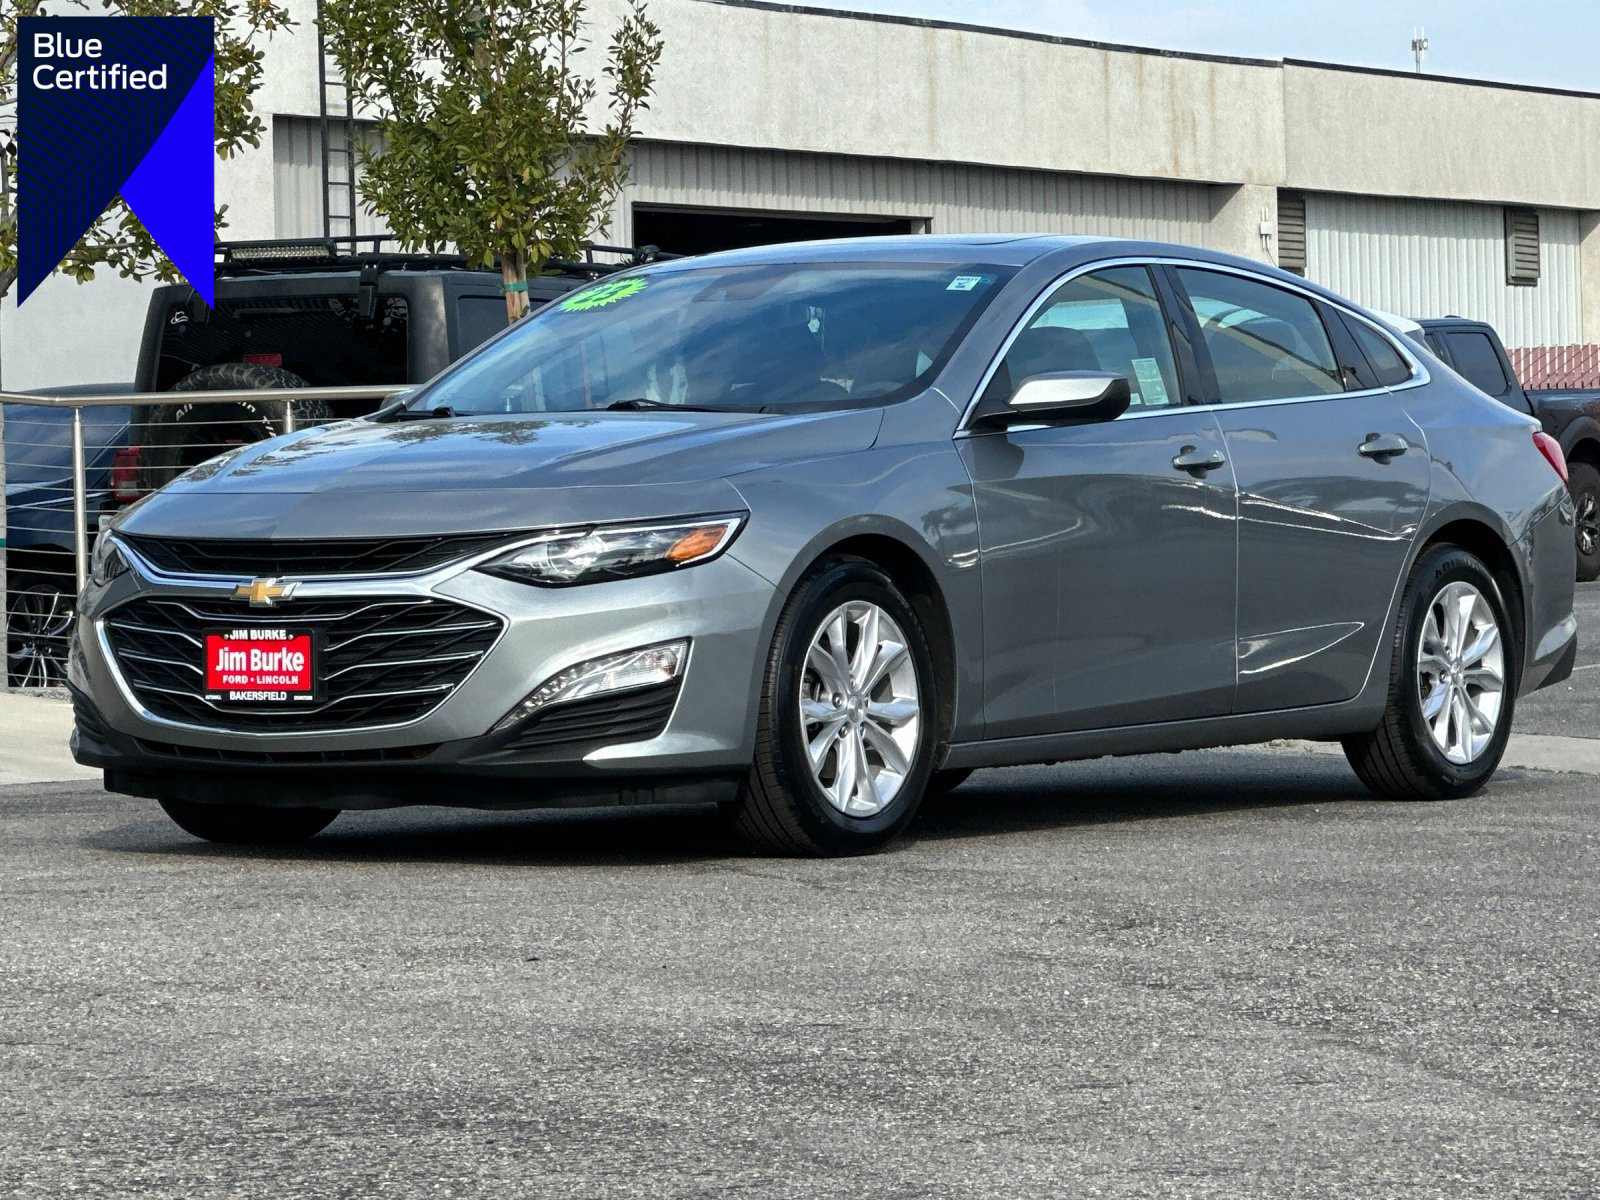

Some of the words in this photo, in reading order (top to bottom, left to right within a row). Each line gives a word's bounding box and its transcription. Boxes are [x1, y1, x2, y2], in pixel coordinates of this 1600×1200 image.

[230, 630, 248, 640] JIM
[250, 630, 287, 640] BURKE
[215, 647, 246, 671] Jim
[250, 647, 305, 671] Burke
[223, 675, 248, 684] FORD
[256, 676, 298, 684] LINCOLN
[229, 691, 287, 700] BAKERSFIELD
